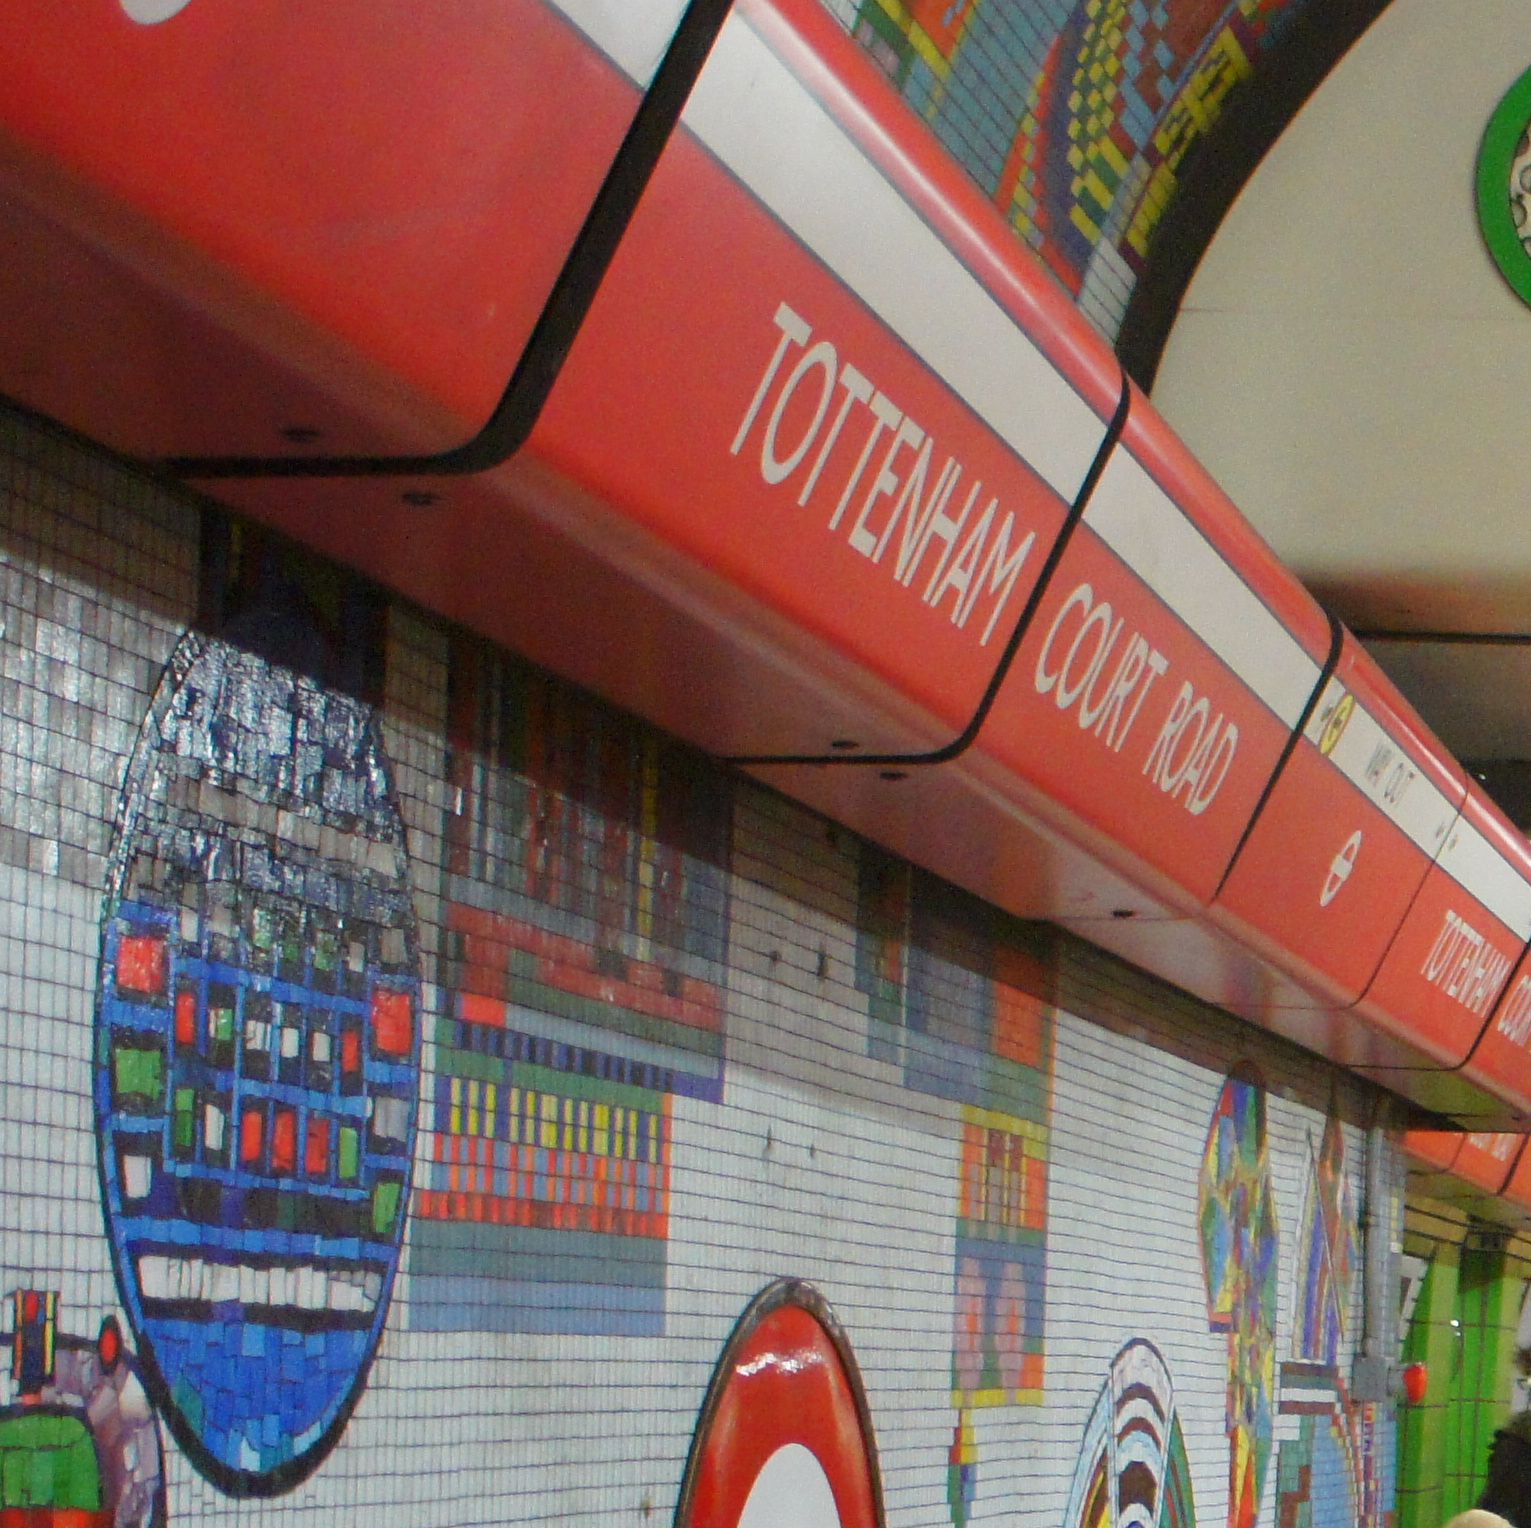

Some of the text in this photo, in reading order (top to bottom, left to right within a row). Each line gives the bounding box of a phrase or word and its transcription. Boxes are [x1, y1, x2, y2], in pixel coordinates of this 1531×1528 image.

[730, 301, 1240, 816] TOTTENHAM COURT ROAD
